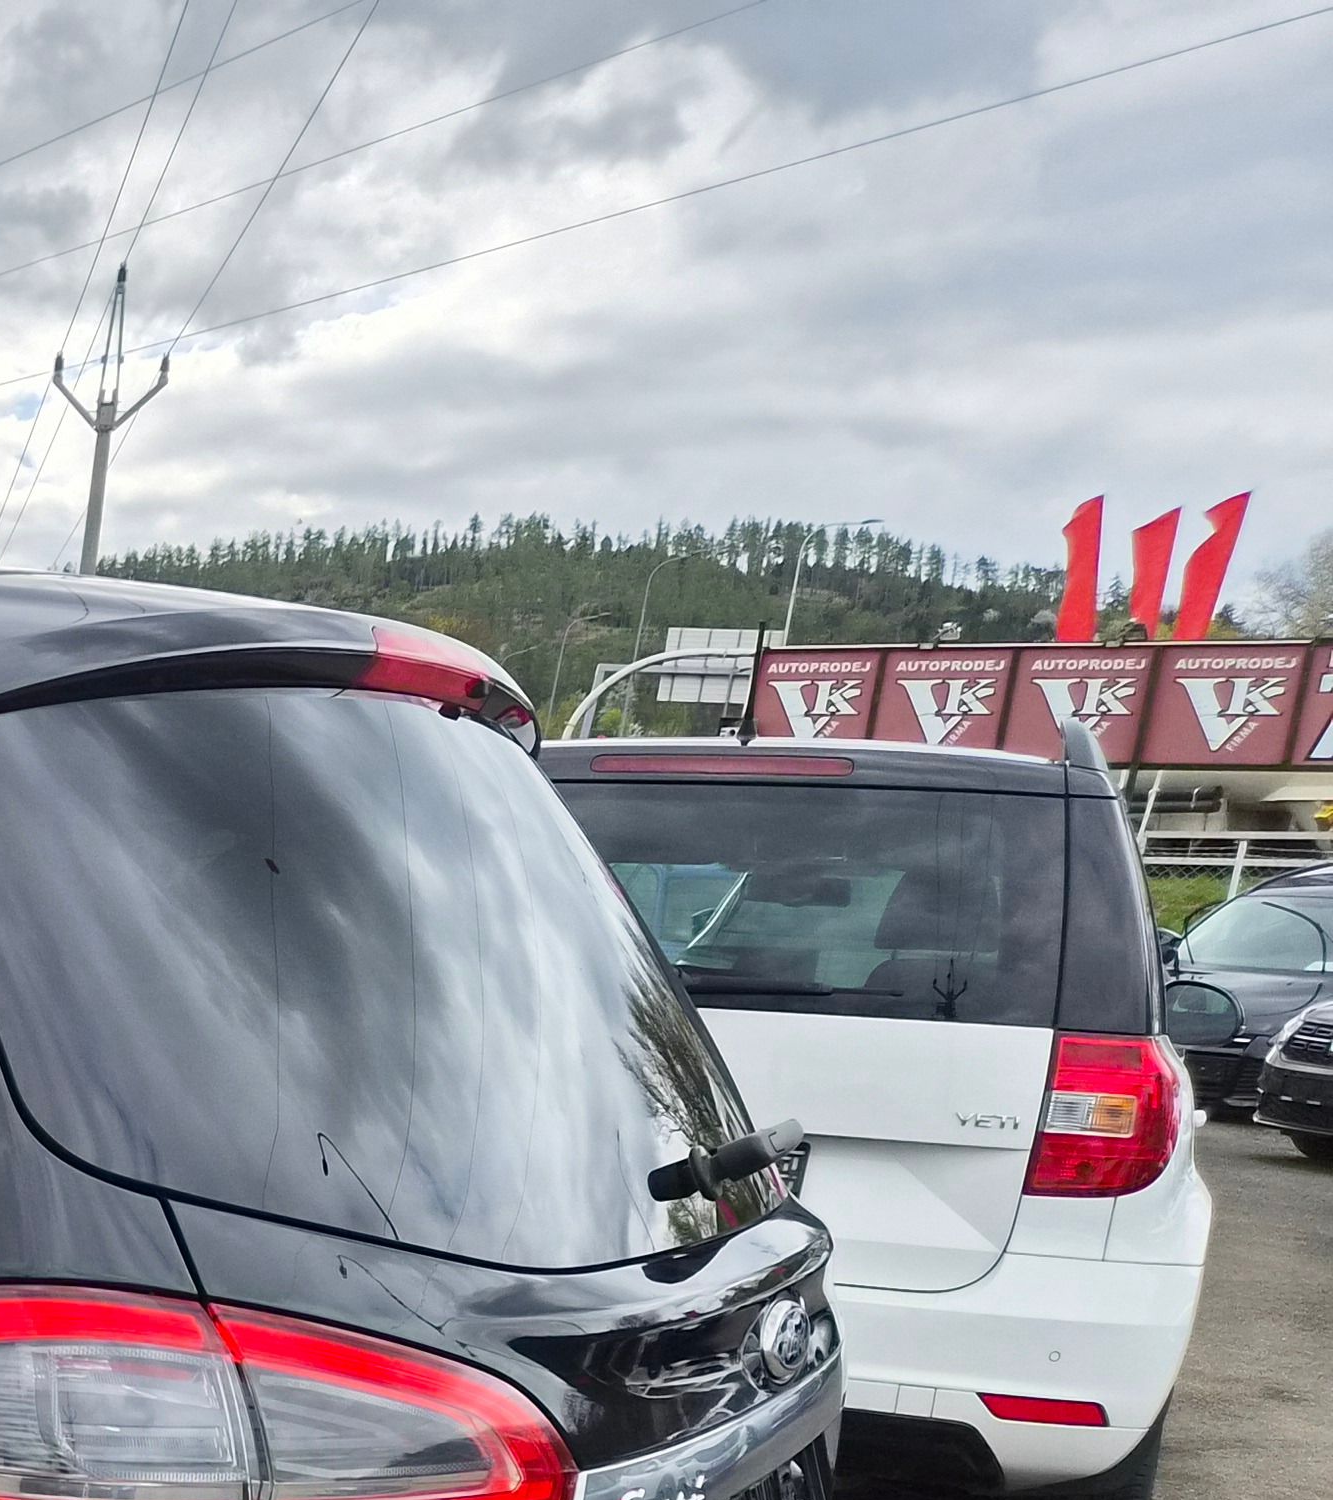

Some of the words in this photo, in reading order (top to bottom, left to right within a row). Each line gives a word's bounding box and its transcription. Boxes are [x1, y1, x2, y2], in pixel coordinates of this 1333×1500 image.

[767, 661, 872, 673] AUTOPRODEJ
[895, 658, 1007, 673] AUTOPRODEJ
[1030, 658, 1147, 672] AUTOPRODEJ
[1174, 657, 1298, 670] AUTOPRODEJ
[1225, 721, 1260, 752] FIRMA
[955, 1111, 1022, 1130] YETI
